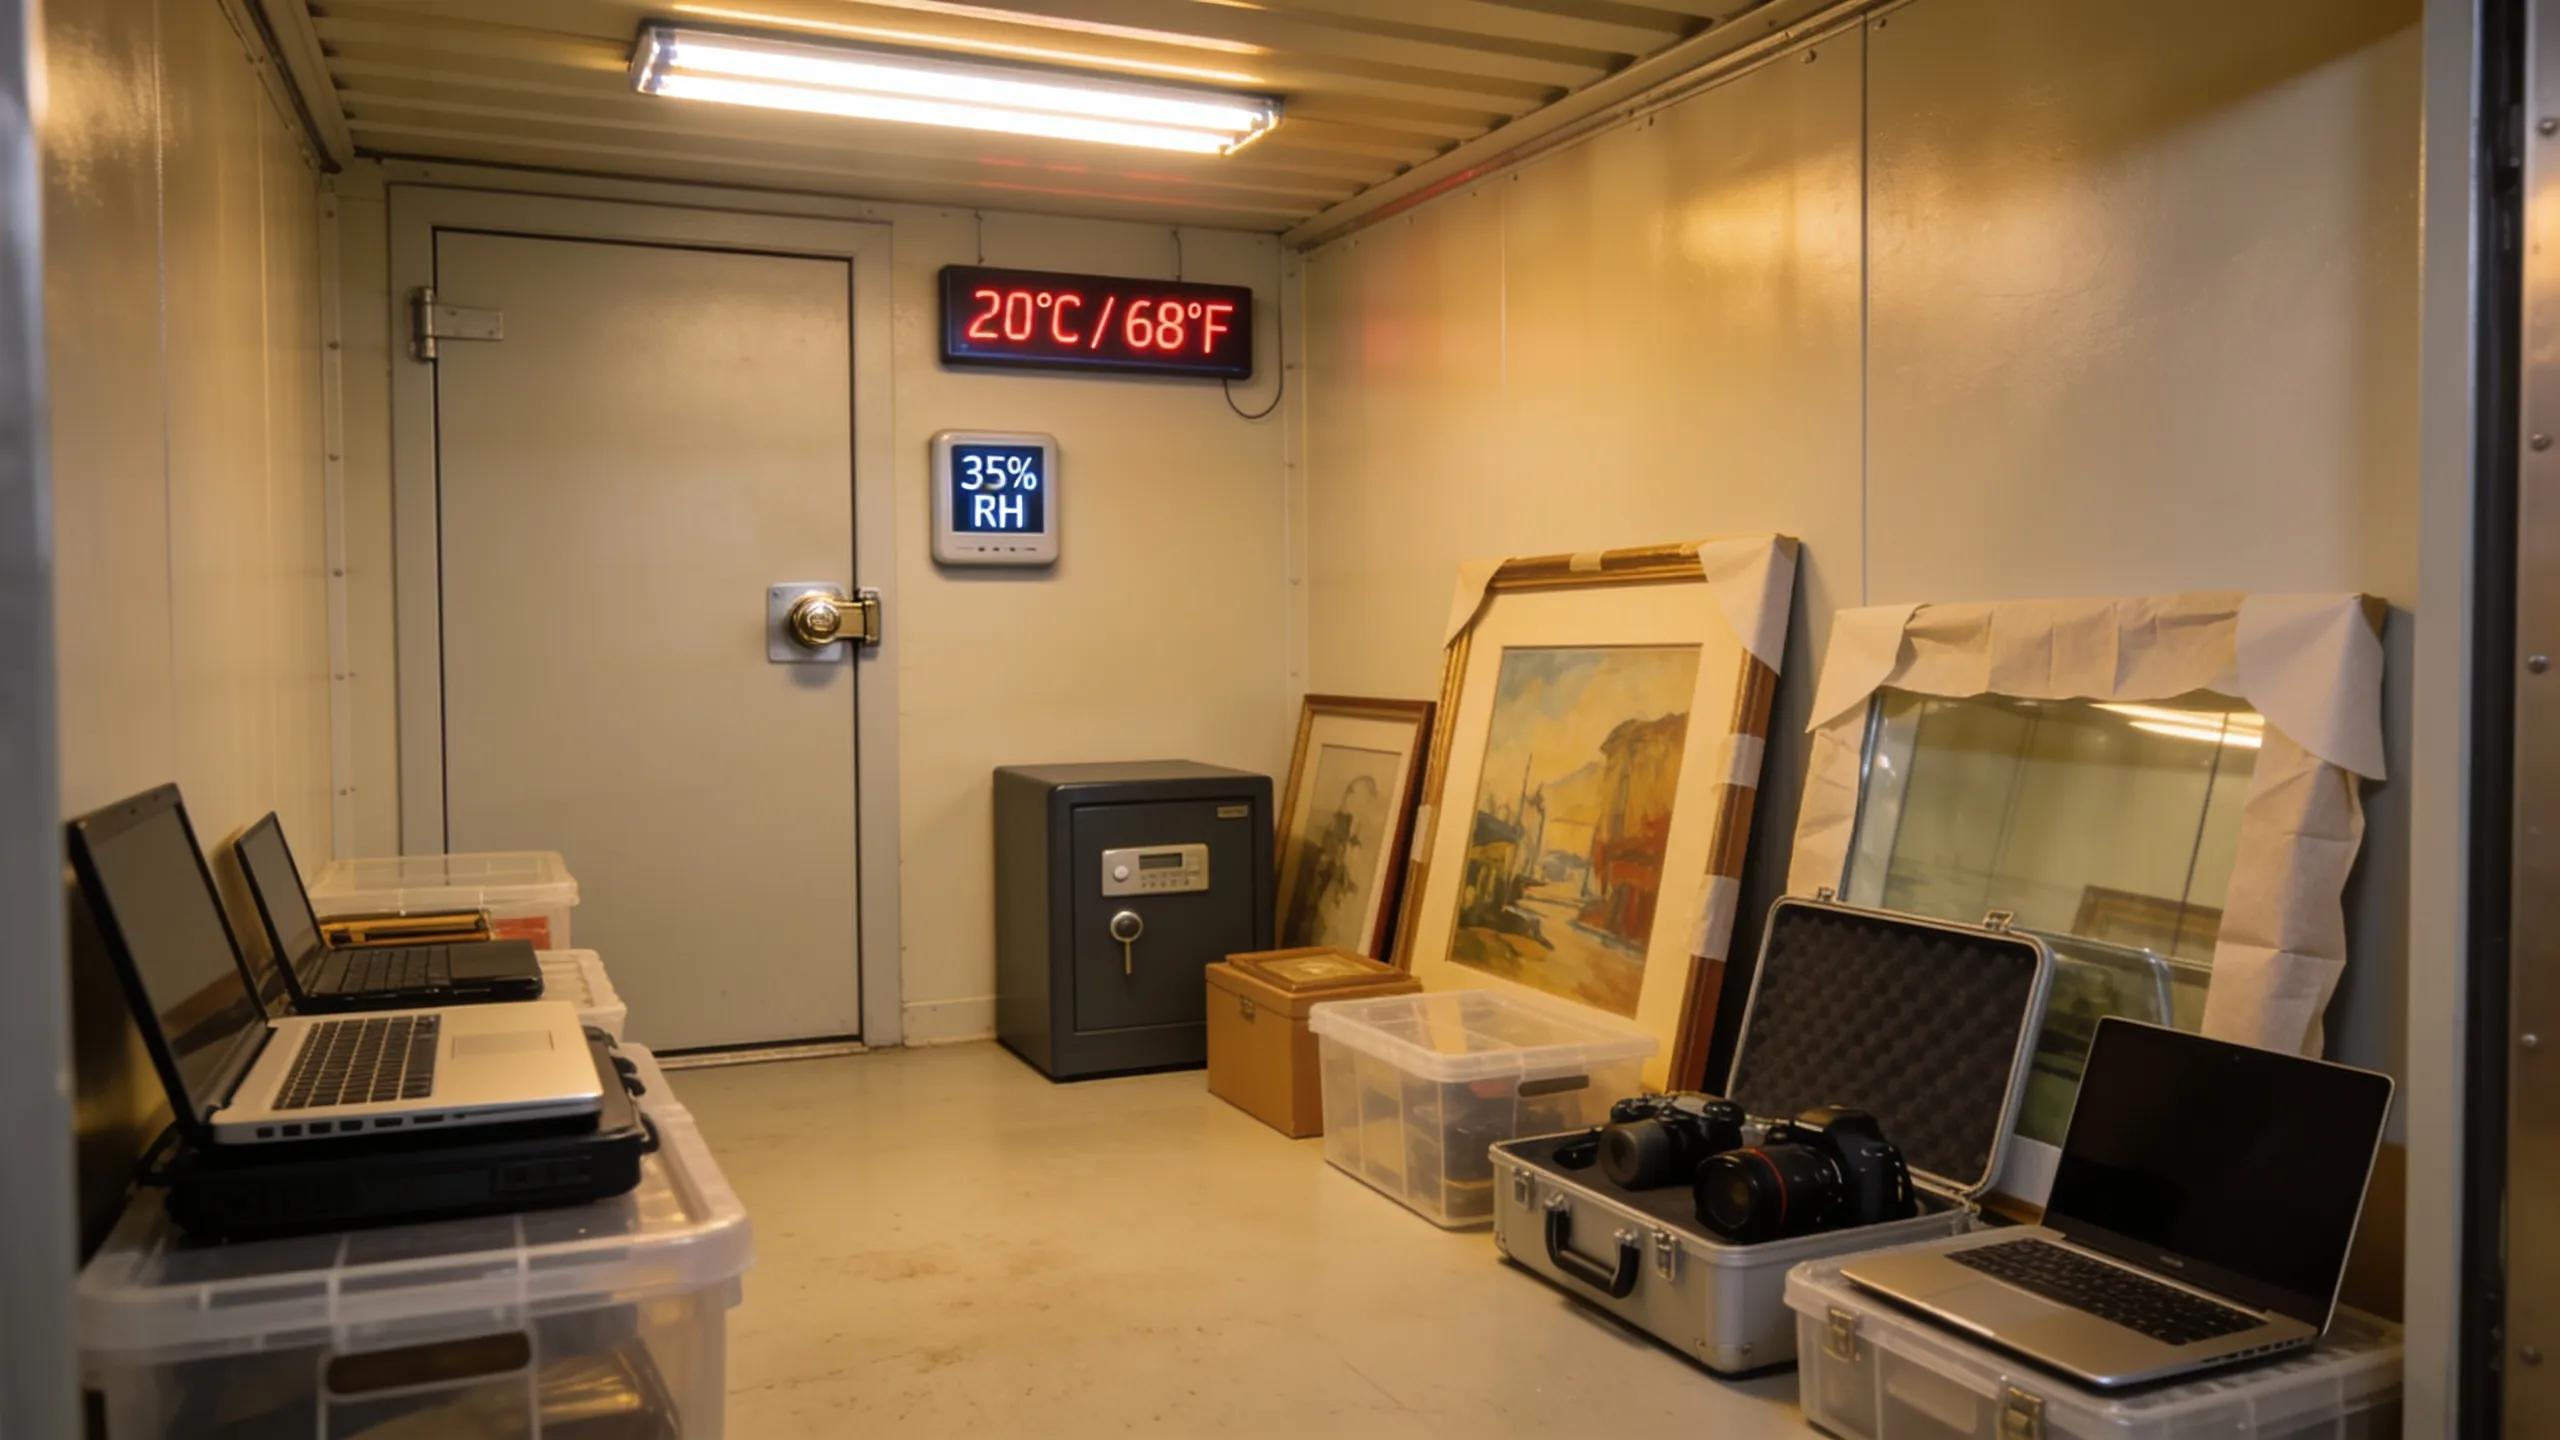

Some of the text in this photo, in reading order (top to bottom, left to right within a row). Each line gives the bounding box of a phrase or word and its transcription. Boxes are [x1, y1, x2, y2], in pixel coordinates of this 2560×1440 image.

[967, 289, 1234, 355] 20°C / 68°F
[960, 454, 1038, 491] 35%
[973, 493, 1024, 529] RH
